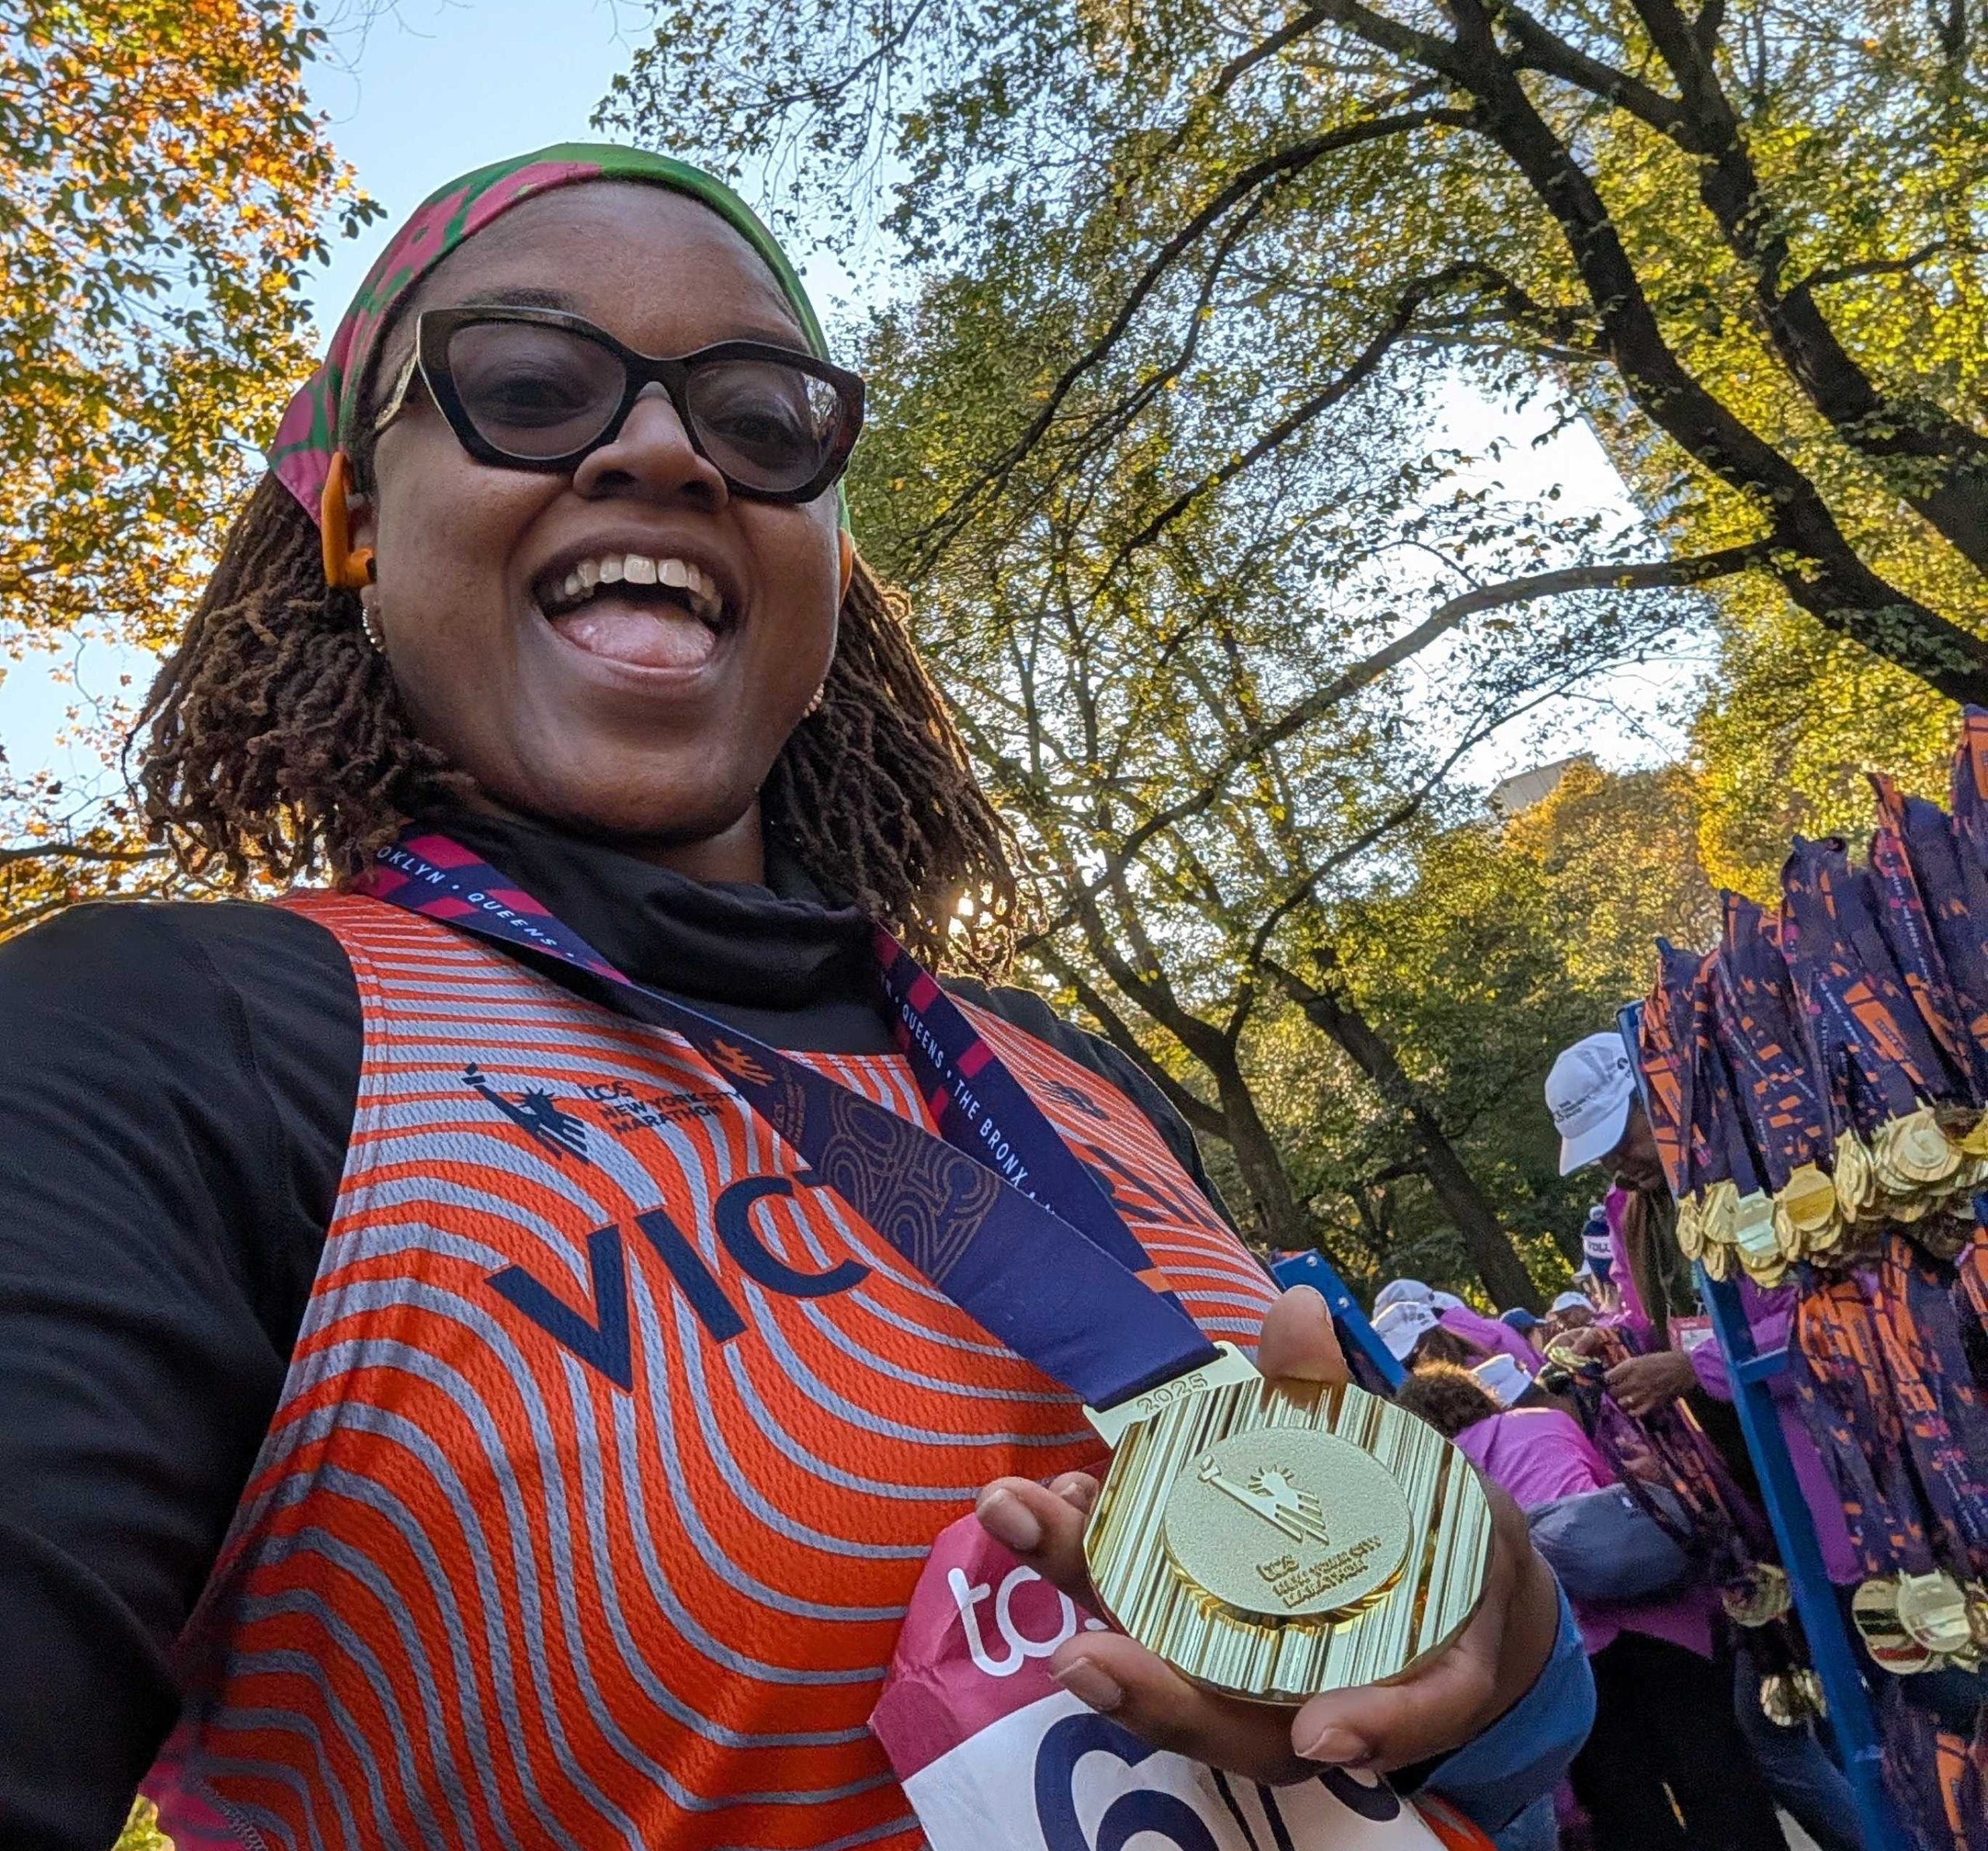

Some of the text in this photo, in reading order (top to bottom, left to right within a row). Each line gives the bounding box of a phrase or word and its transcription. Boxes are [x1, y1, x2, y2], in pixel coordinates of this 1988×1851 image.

[377, 846, 558, 946] OKLYN QUEENS
[902, 1003, 1029, 1188] QUEENS THE BRONX
[484, 1174, 872, 1392] VIC
[1137, 1373, 1208, 1414] 2025
